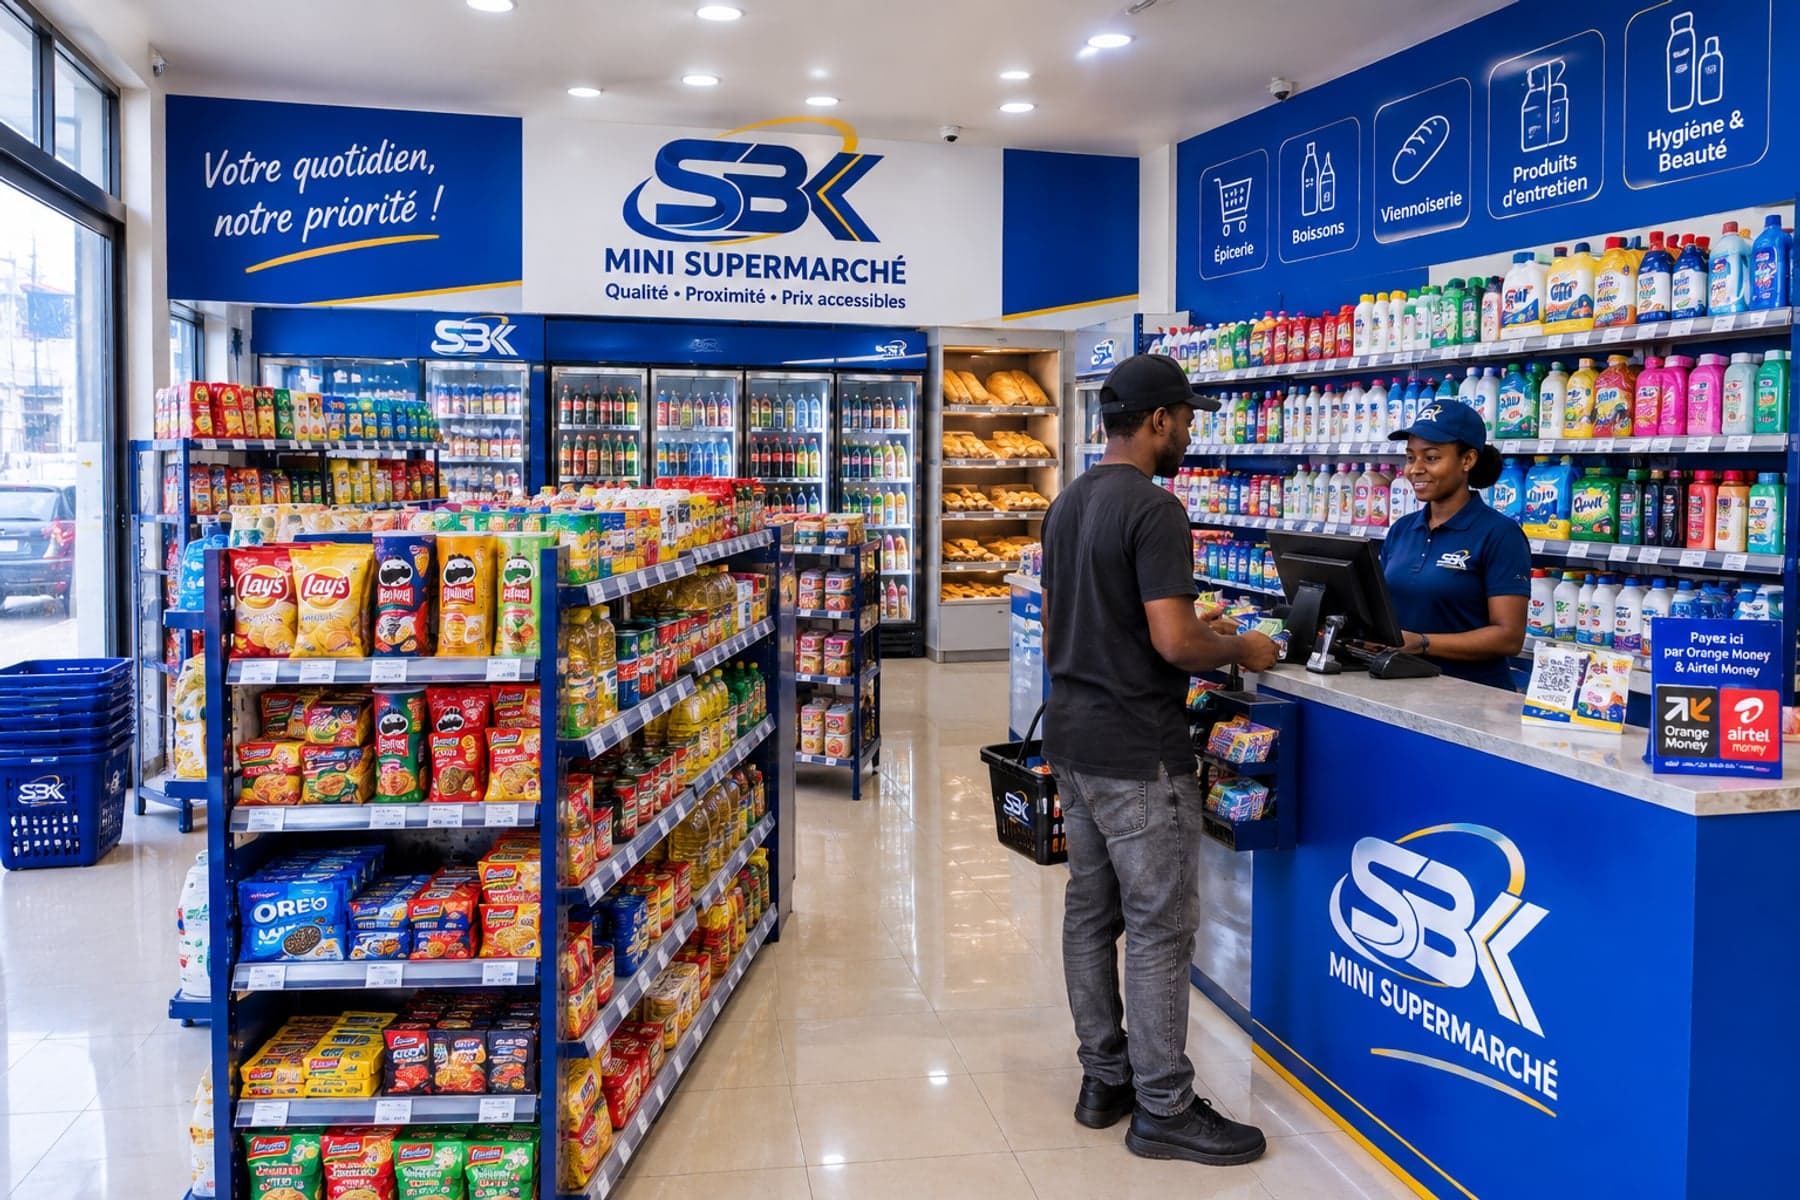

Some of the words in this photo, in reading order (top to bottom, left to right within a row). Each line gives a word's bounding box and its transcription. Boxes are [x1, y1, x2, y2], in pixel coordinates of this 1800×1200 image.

[1729, 110, 1744, 129] &
[204, 149, 281, 188] Votre
[294, 139, 435, 194] quotidien,
[1513, 154, 1577, 183] Produits
[1659, 138, 1728, 173] Beauté
[623, 136, 884, 245] SBK
[1503, 176, 1588, 208] d'entretien
[214, 201, 292, 237] notre
[302, 190, 417, 243] priorité
[1381, 191, 1462, 223] Viennoiserie
[1292, 222, 1345, 244] Boissons
[605, 247, 674, 275] MINI
[684, 250, 906, 285] SUPERMARCHÉ
[1214, 241, 1254, 264] Épicerie
[605, 283, 668, 301] Qualité
[686, 286, 766, 304] Proximité
[782, 289, 813, 306] Prix
[818, 292, 906, 309] accessibles
[431, 318, 518, 356] SBK
[1690, 632, 1727, 646] Payez
[1729, 633, 1744, 645] ici
[1664, 648, 1683, 658] par
[1686, 647, 1729, 661] Orange
[1732, 649, 1771, 664] Money
[1674, 661, 1684, 673] &
[1686, 662, 1718, 674] Airtel
[1721, 664, 1760, 678] Money
[1664, 725, 1710, 740] Orange
[1665, 738, 1708, 753] Money
[1727, 727, 1770, 742] airtel
[18, 780, 65, 804] SBK
[254, 896, 328, 924] OREO
[1329, 835, 1550, 1039] SBK
[1329, 951, 1374, 1000] MINI
[1380, 978, 1559, 1101] SUPERMARCHÉ
